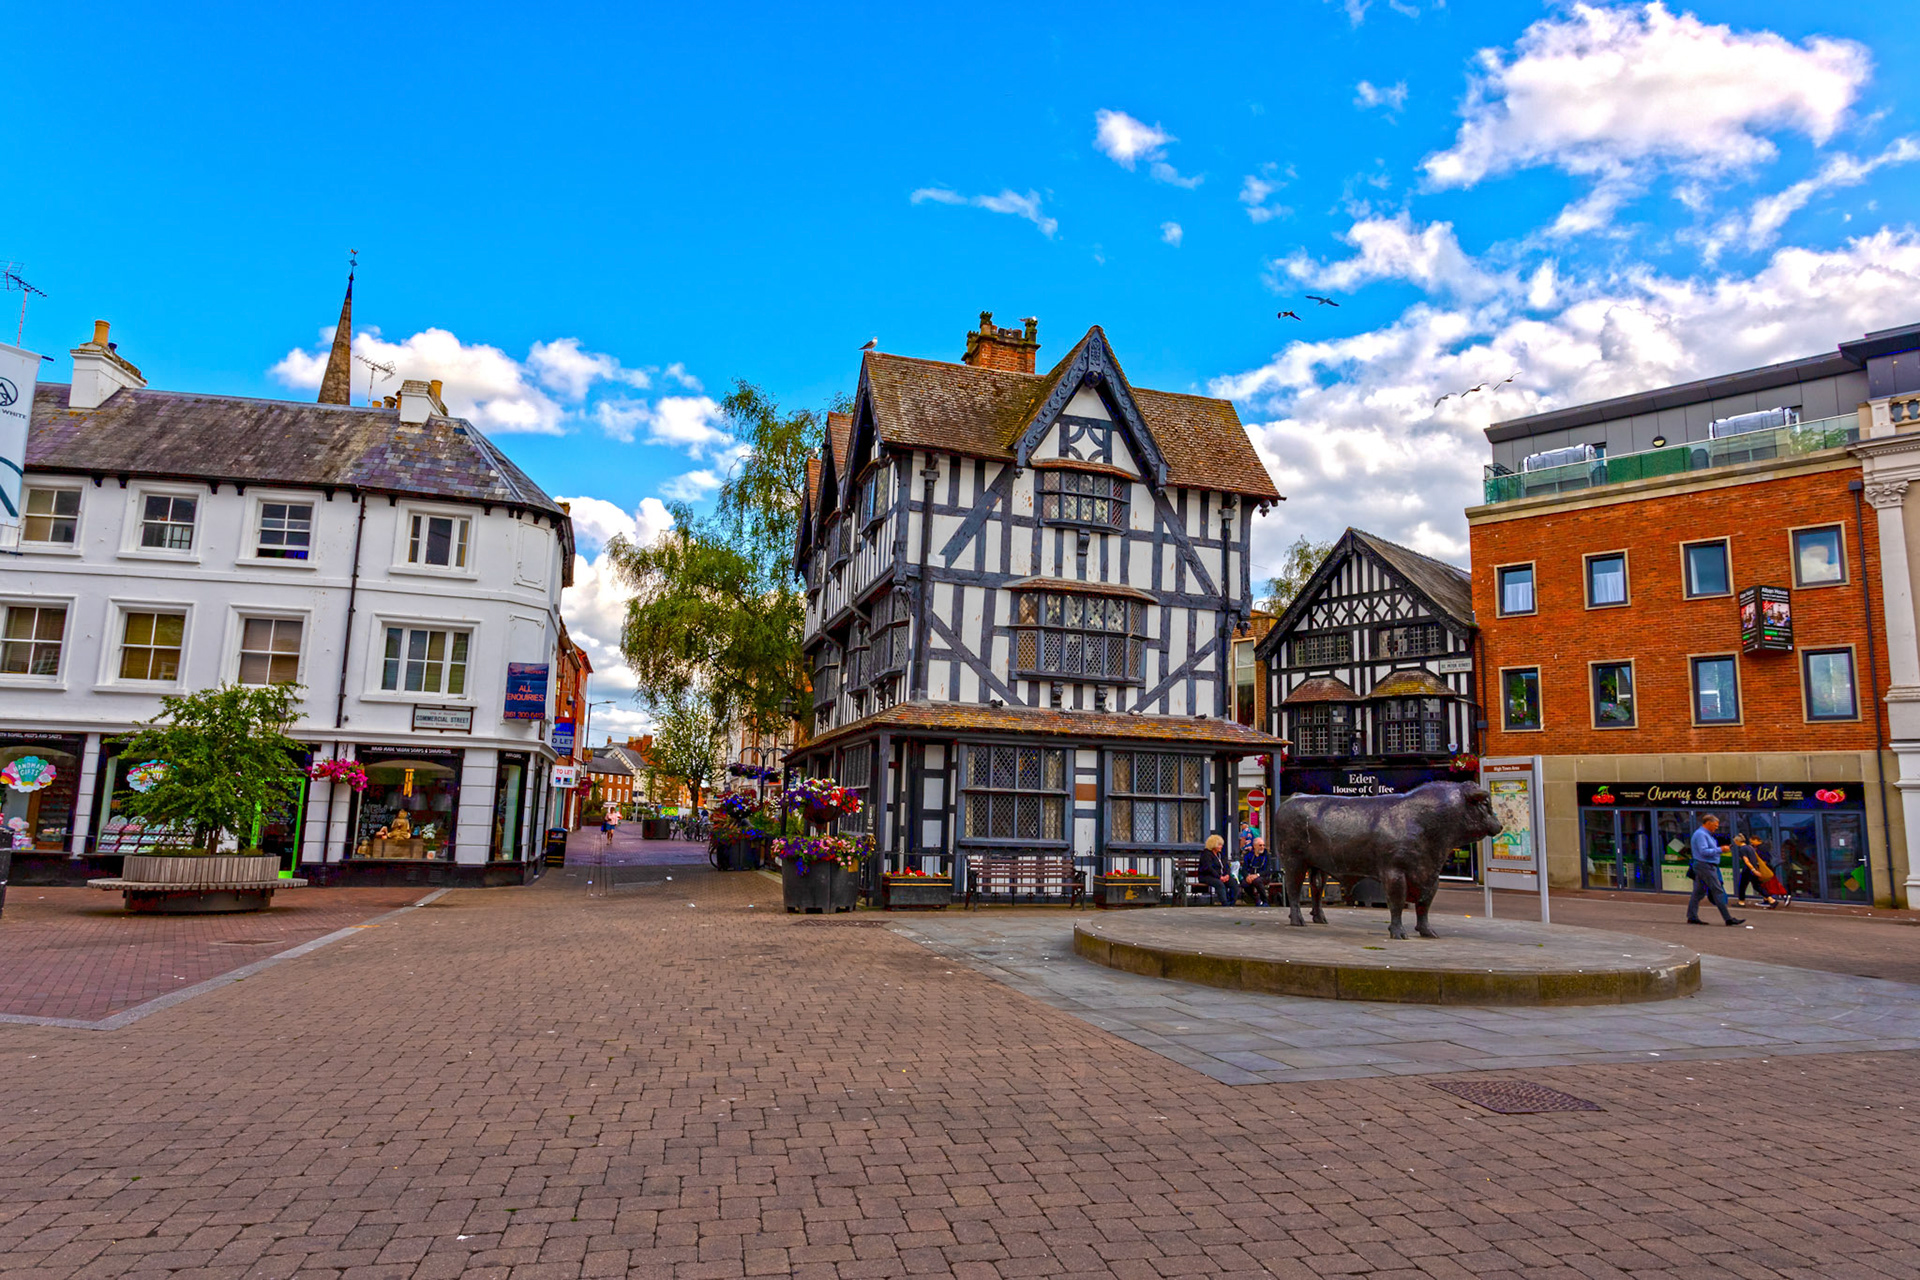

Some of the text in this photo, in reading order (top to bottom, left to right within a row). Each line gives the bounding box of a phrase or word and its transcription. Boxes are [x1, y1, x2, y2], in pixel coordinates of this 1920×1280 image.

[1, 408, 27, 419] WHITE
[518, 684, 533, 692] ALL
[506, 693, 545, 702] ENQUIRIES
[415, 714, 469, 724] COMMERCIAL STREET
[13, 762, 47, 773] HANDMADE
[20, 769, 40, 777] GIFTS
[1349, 773, 1376, 784] Eder
[1332, 785, 1395, 794] House of Cffee
[1647, 785, 1778, 802] Cherries & Berries Ltd
